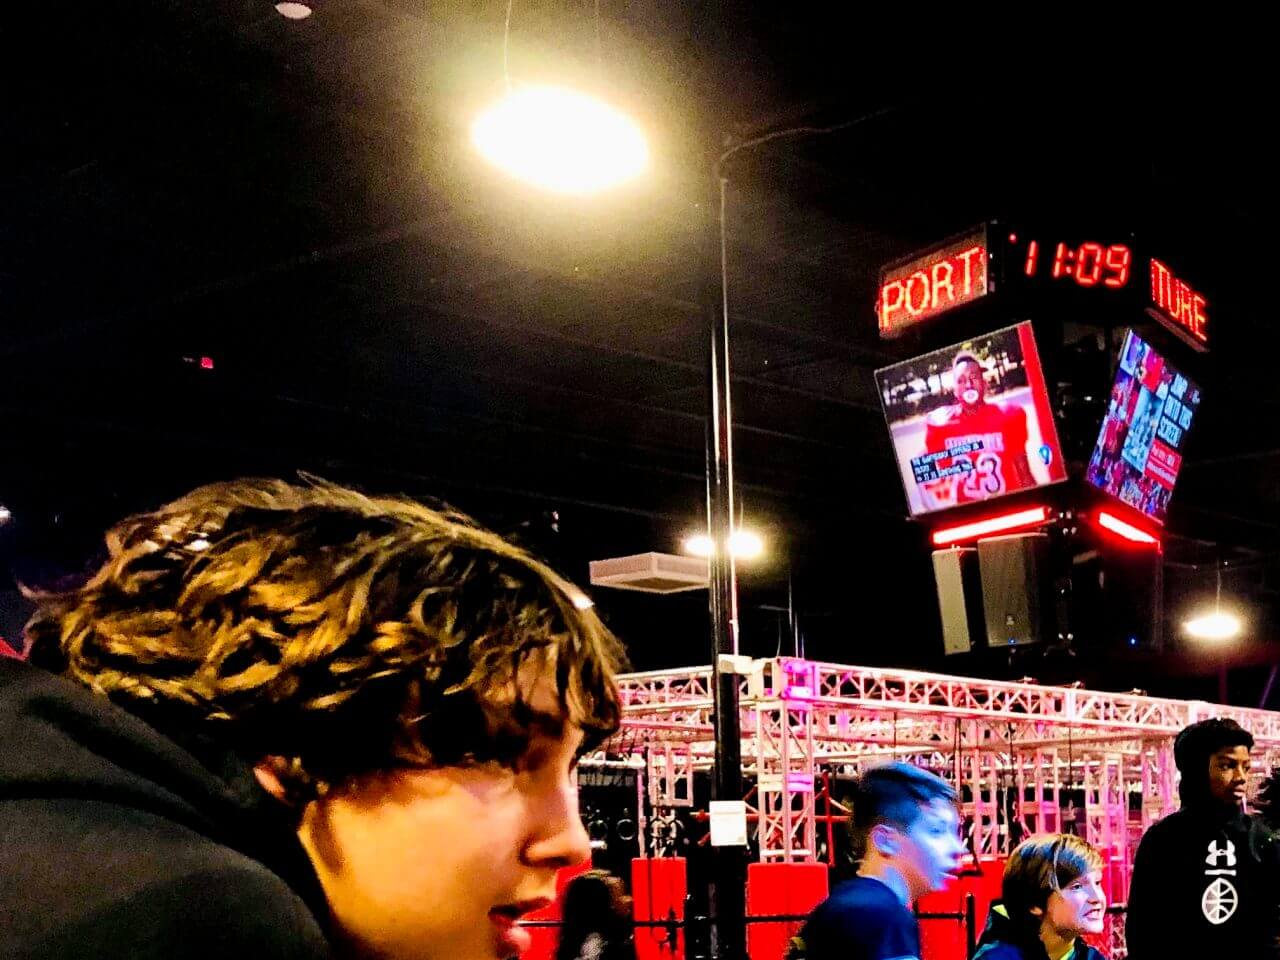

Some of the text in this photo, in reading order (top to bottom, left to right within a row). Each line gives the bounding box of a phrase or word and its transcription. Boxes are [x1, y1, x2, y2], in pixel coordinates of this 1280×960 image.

[881, 247, 980, 329] PORT
[1025, 240, 1130, 286] 11:09
[1151, 258, 1207, 341] TURE
